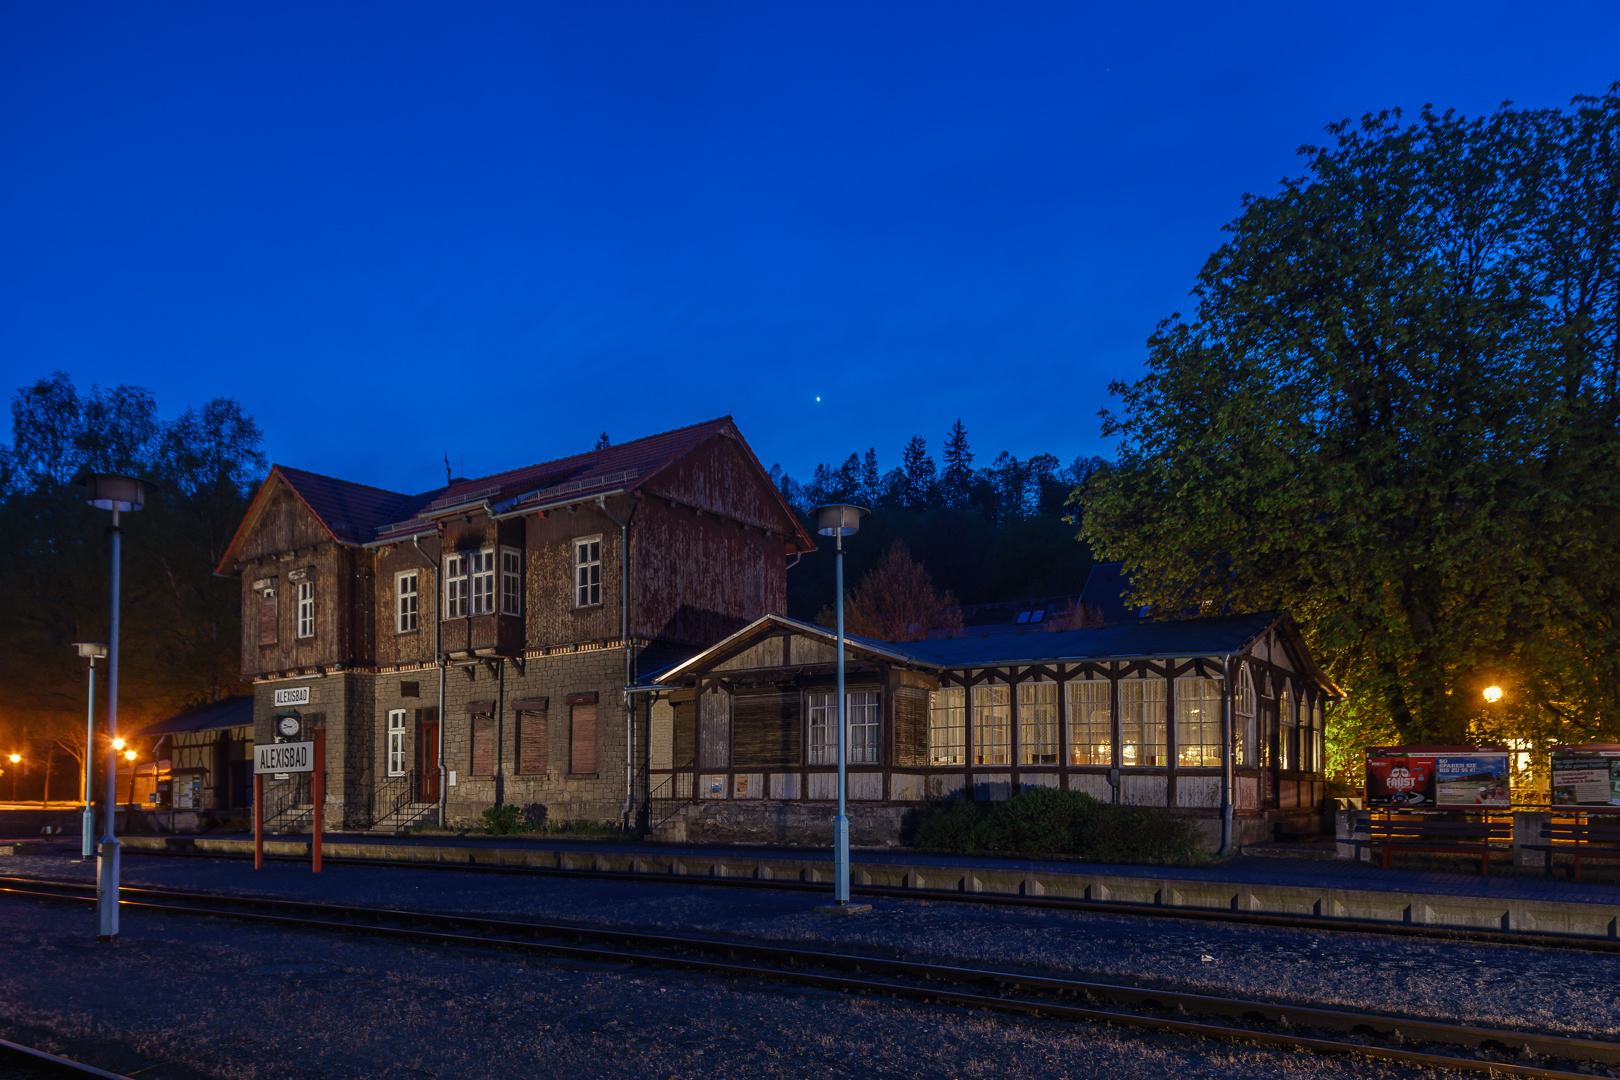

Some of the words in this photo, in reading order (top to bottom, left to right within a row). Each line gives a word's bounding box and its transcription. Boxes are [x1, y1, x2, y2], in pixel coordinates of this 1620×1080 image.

[276, 689, 307, 703] ALEXISBAD
[260, 747, 307, 769] ALEXISBAD
[1386, 777, 1416, 787] FAUST
